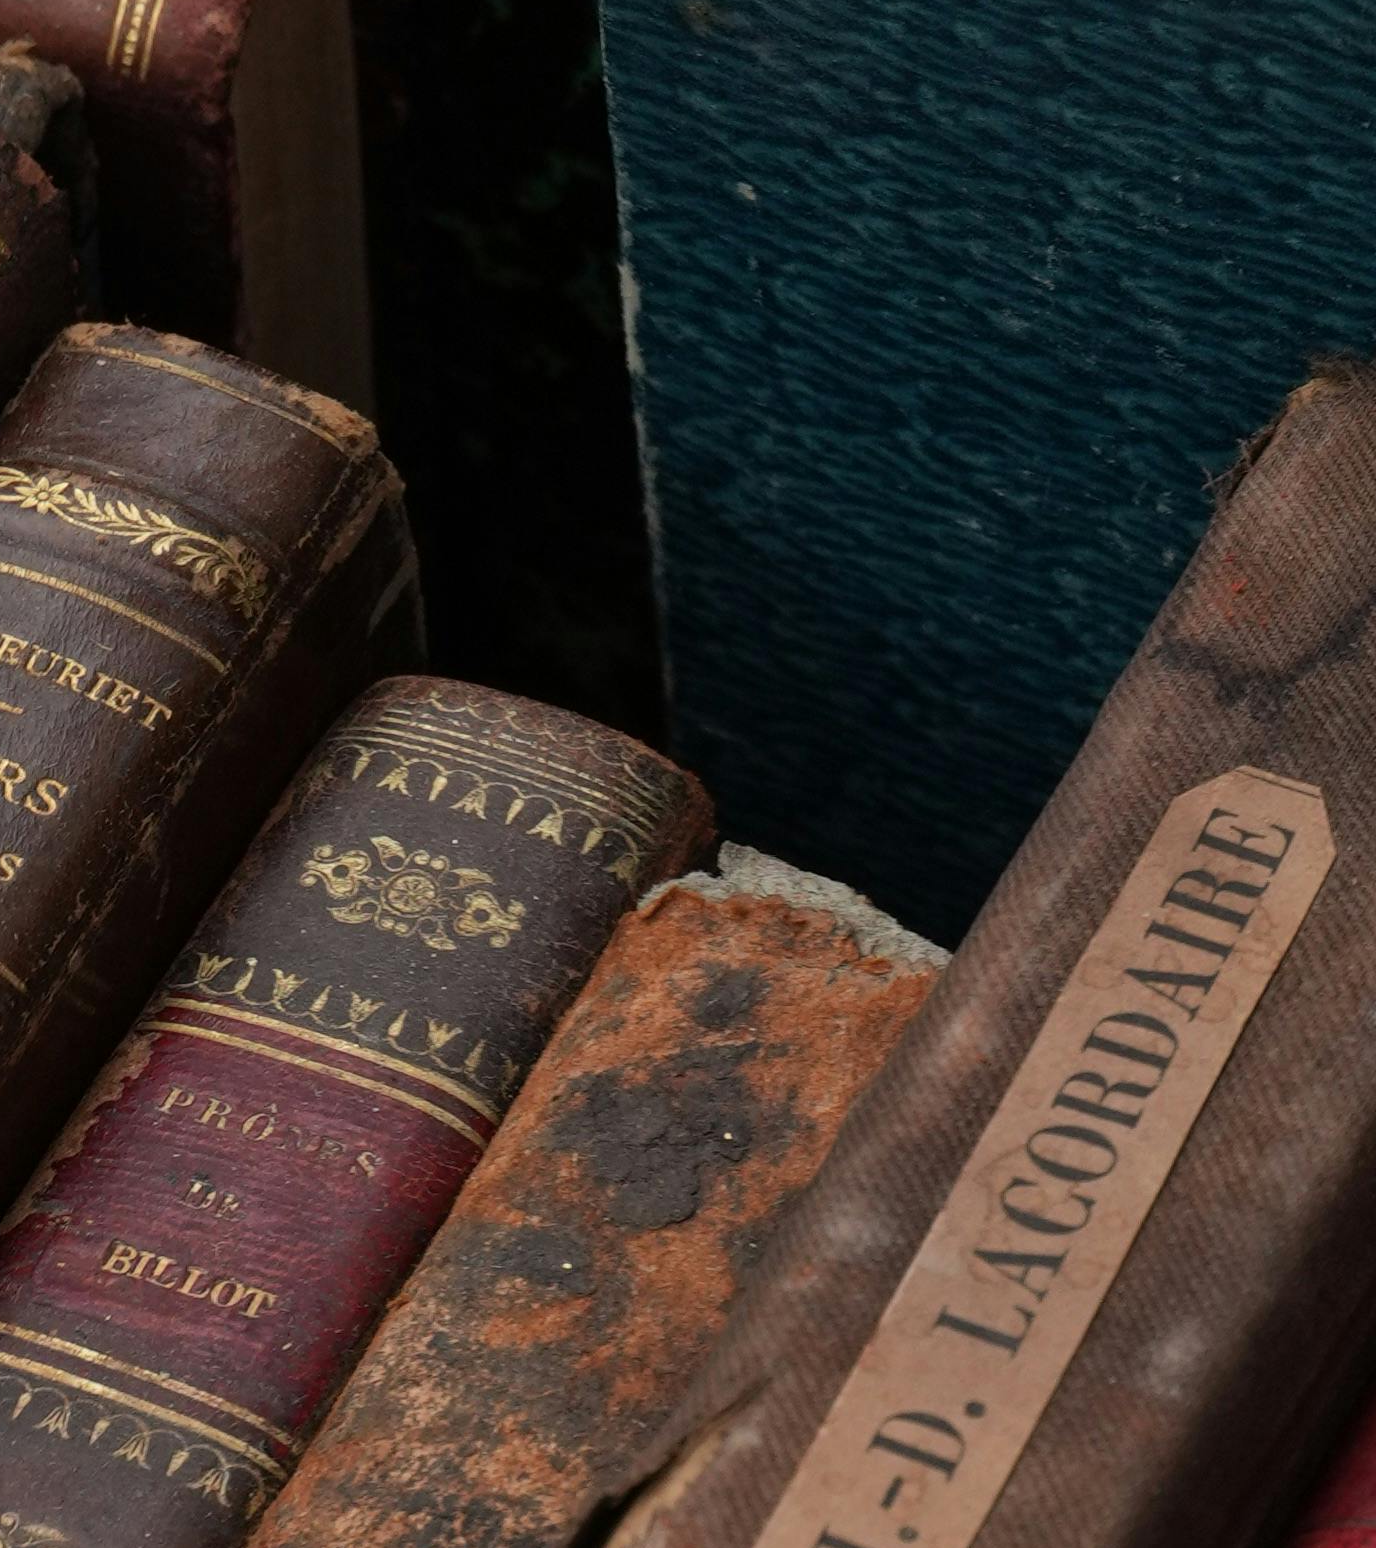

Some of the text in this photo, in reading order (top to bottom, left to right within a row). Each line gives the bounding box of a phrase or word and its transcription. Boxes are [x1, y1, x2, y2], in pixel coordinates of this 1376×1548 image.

[931, 805, 1302, 1361] LACORDAIRE
[181, 1174, 248, 1223] DE
[100, 1240, 280, 1320] BILLOT
